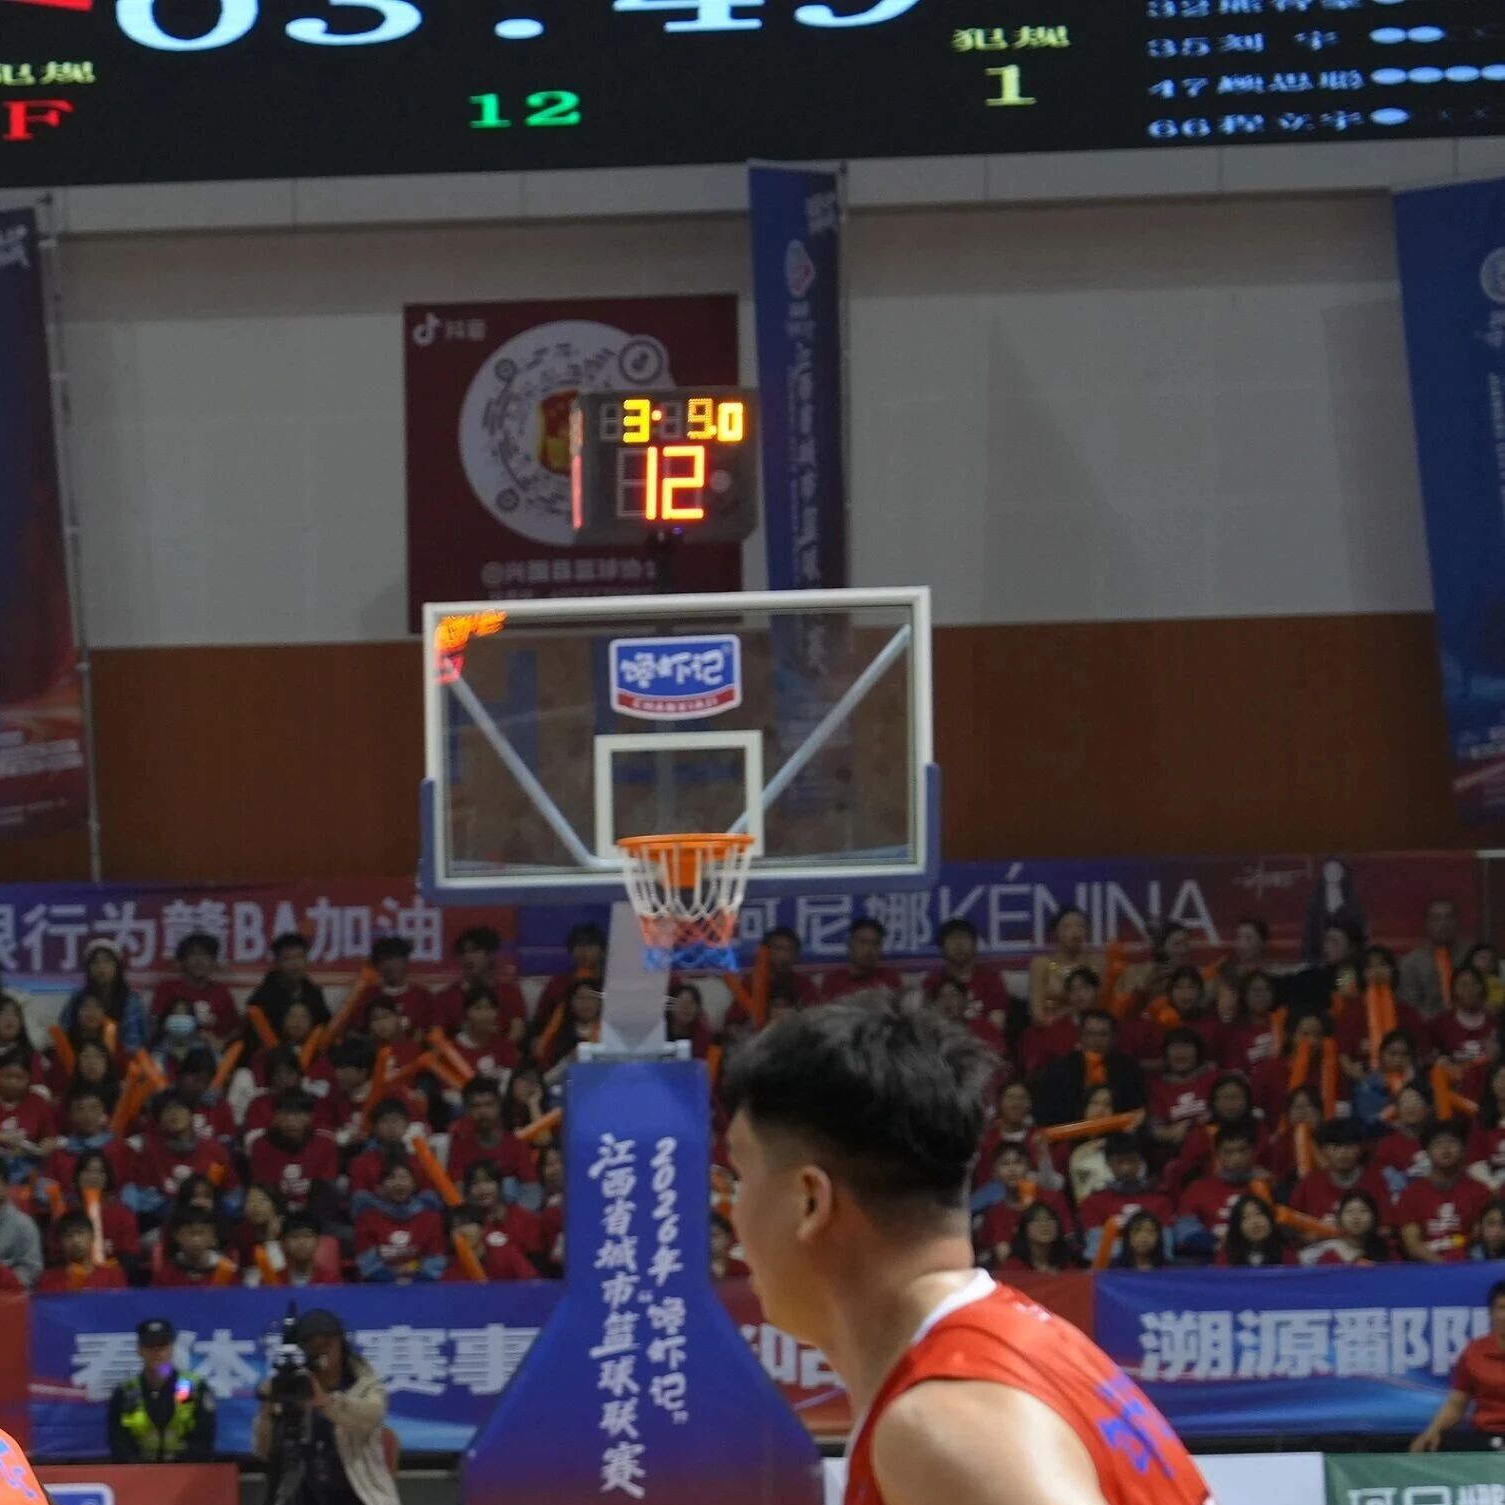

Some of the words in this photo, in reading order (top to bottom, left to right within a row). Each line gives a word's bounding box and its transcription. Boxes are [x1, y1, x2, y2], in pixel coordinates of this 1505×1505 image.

[985, 64, 1037, 106] 1
[2, 100, 75, 141] F
[469, 90, 581, 129] 12
[646, 446, 705, 520] 12
[588, 1132, 646, 1500] 江西省城市篮球联赛
